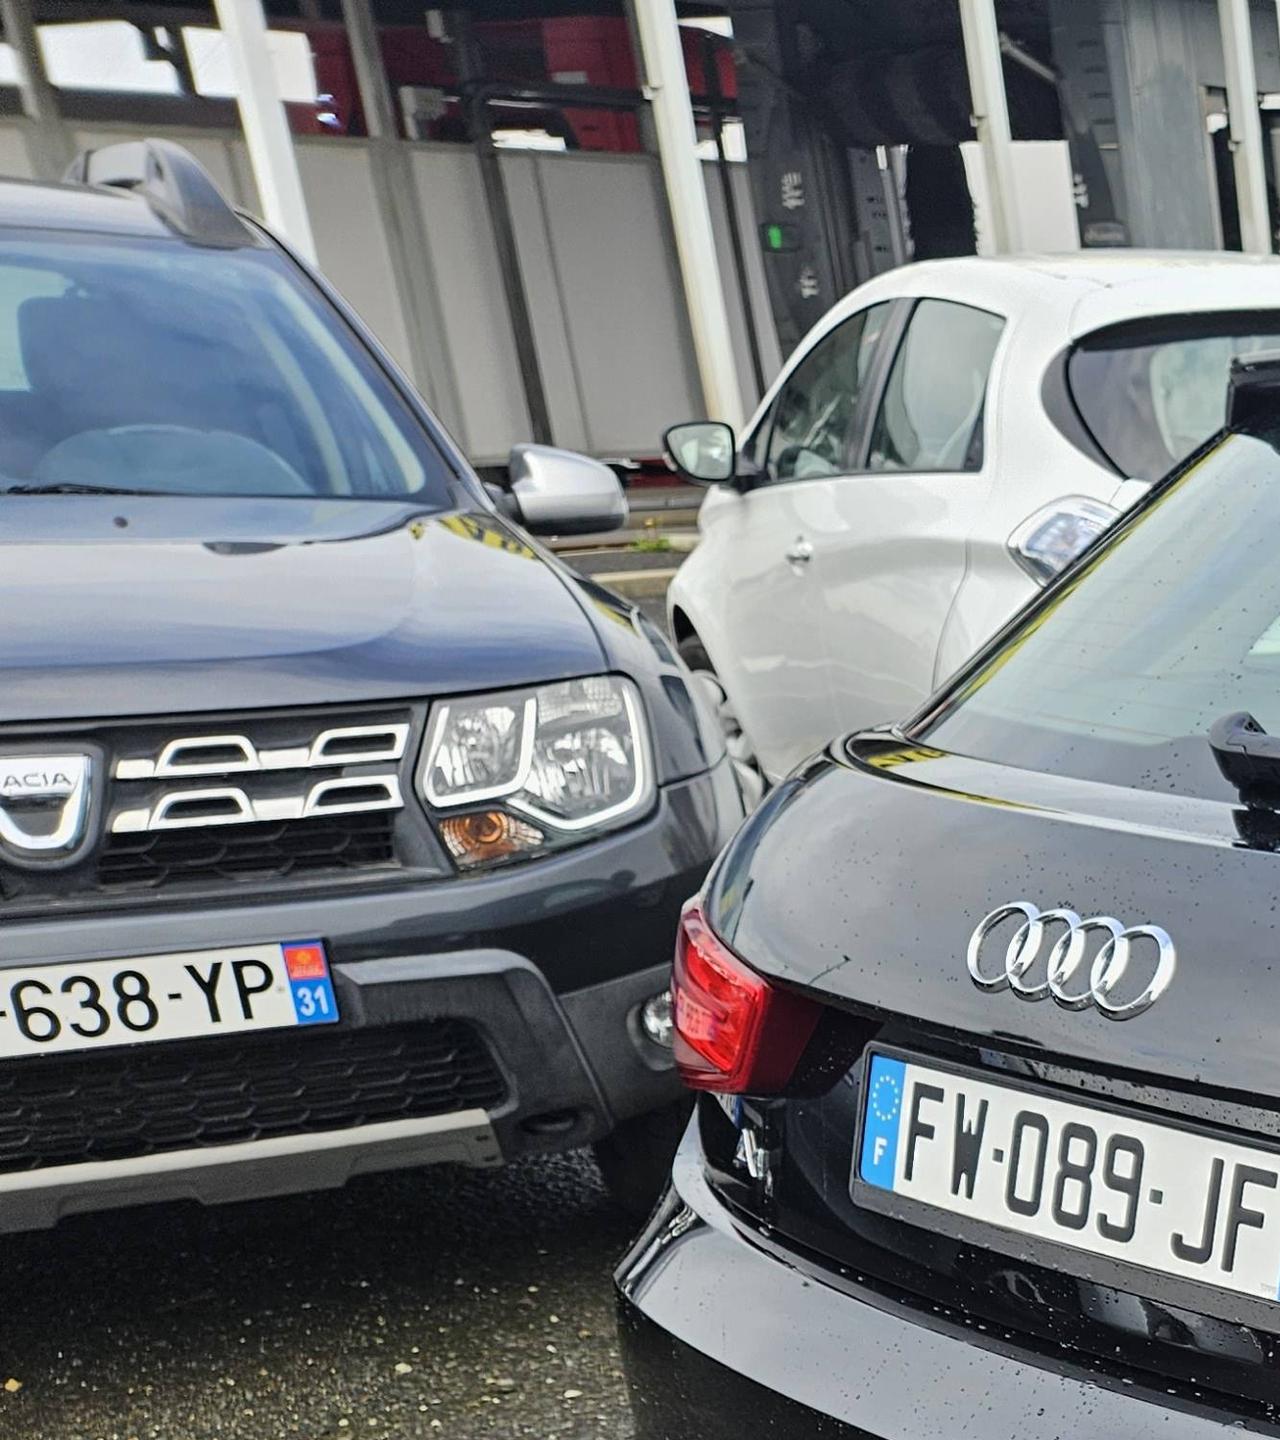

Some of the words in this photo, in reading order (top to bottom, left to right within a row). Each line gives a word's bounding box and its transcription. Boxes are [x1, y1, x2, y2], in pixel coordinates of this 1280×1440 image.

[2, 772, 72, 789] ACIA
[297, 985, 329, 1017] 31
[872, 1138, 887, 1167] F
